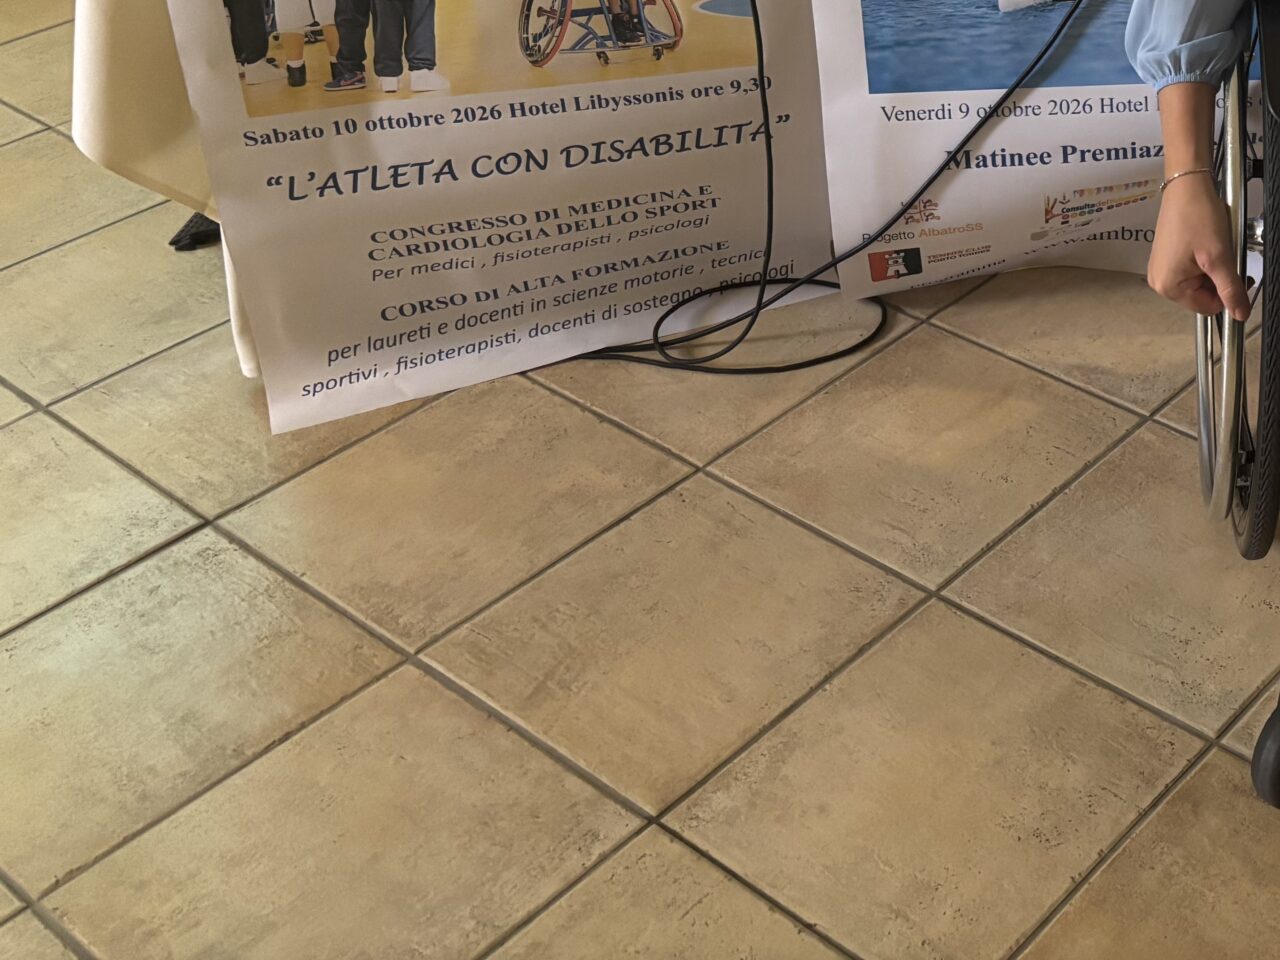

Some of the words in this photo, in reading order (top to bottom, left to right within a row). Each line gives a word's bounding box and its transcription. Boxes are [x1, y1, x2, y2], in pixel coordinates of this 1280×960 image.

[243, 124, 324, 147] Sabato
[332, 118, 358, 137] 10
[365, 111, 446, 132] ottobre
[451, 104, 502, 124] 2026
[509, 96, 568, 119] Hotel
[573, 85, 685, 112] Libyssonis
[690, 83, 725, 99] ore
[729, 75, 772, 96] 9,30
[880, 102, 952, 122] Venerdi
[959, 102, 970, 120] 9
[1047, 98, 1093, 116] 2026
[1099, 96, 1149, 114] Hotel
[471, 148, 548, 178] CON
[944, 147, 1052, 171] Matinee
[1061, 141, 1166, 164] Premiaz
[368, 226, 551, 261] CARDIOLOGIA
[557, 211, 639, 236] DELLO
[645, 197, 722, 220] SPORT
[370, 213, 528, 244] CONGRESSO
[534, 208, 561, 223] DI
[567, 188, 693, 217] MEDICINA
[699, 184, 713, 196] E
[862, 230, 915, 244] Pogetto
[919, 222, 984, 238] AlbatroSS
[372, 267, 404, 282] Per
[411, 256, 475, 276] medici
[492, 232, 611, 267] fisioterapisti
[628, 214, 710, 242] psicologi
[380, 292, 468, 323] CORSO
[475, 287, 500, 303] DI
[506, 273, 567, 296] ALTA
[572, 240, 731, 282] FORMAZIONE
[301, 363, 378, 397] sportivi
[394, 328, 522, 376] fisioterapisti,
[528, 309, 596, 338] docenti
[602, 303, 618, 322] di
[623, 285, 704, 317] sostegno
[719, 259, 795, 296] psicoogi
[327, 342, 361, 367] per
[367, 322, 431, 354] laureti
[437, 321, 449, 335] e
[454, 302, 525, 331] docenti
[530, 296, 547, 313] in
[553, 279, 618, 308] scienze
[624, 261, 695, 290] motorie
